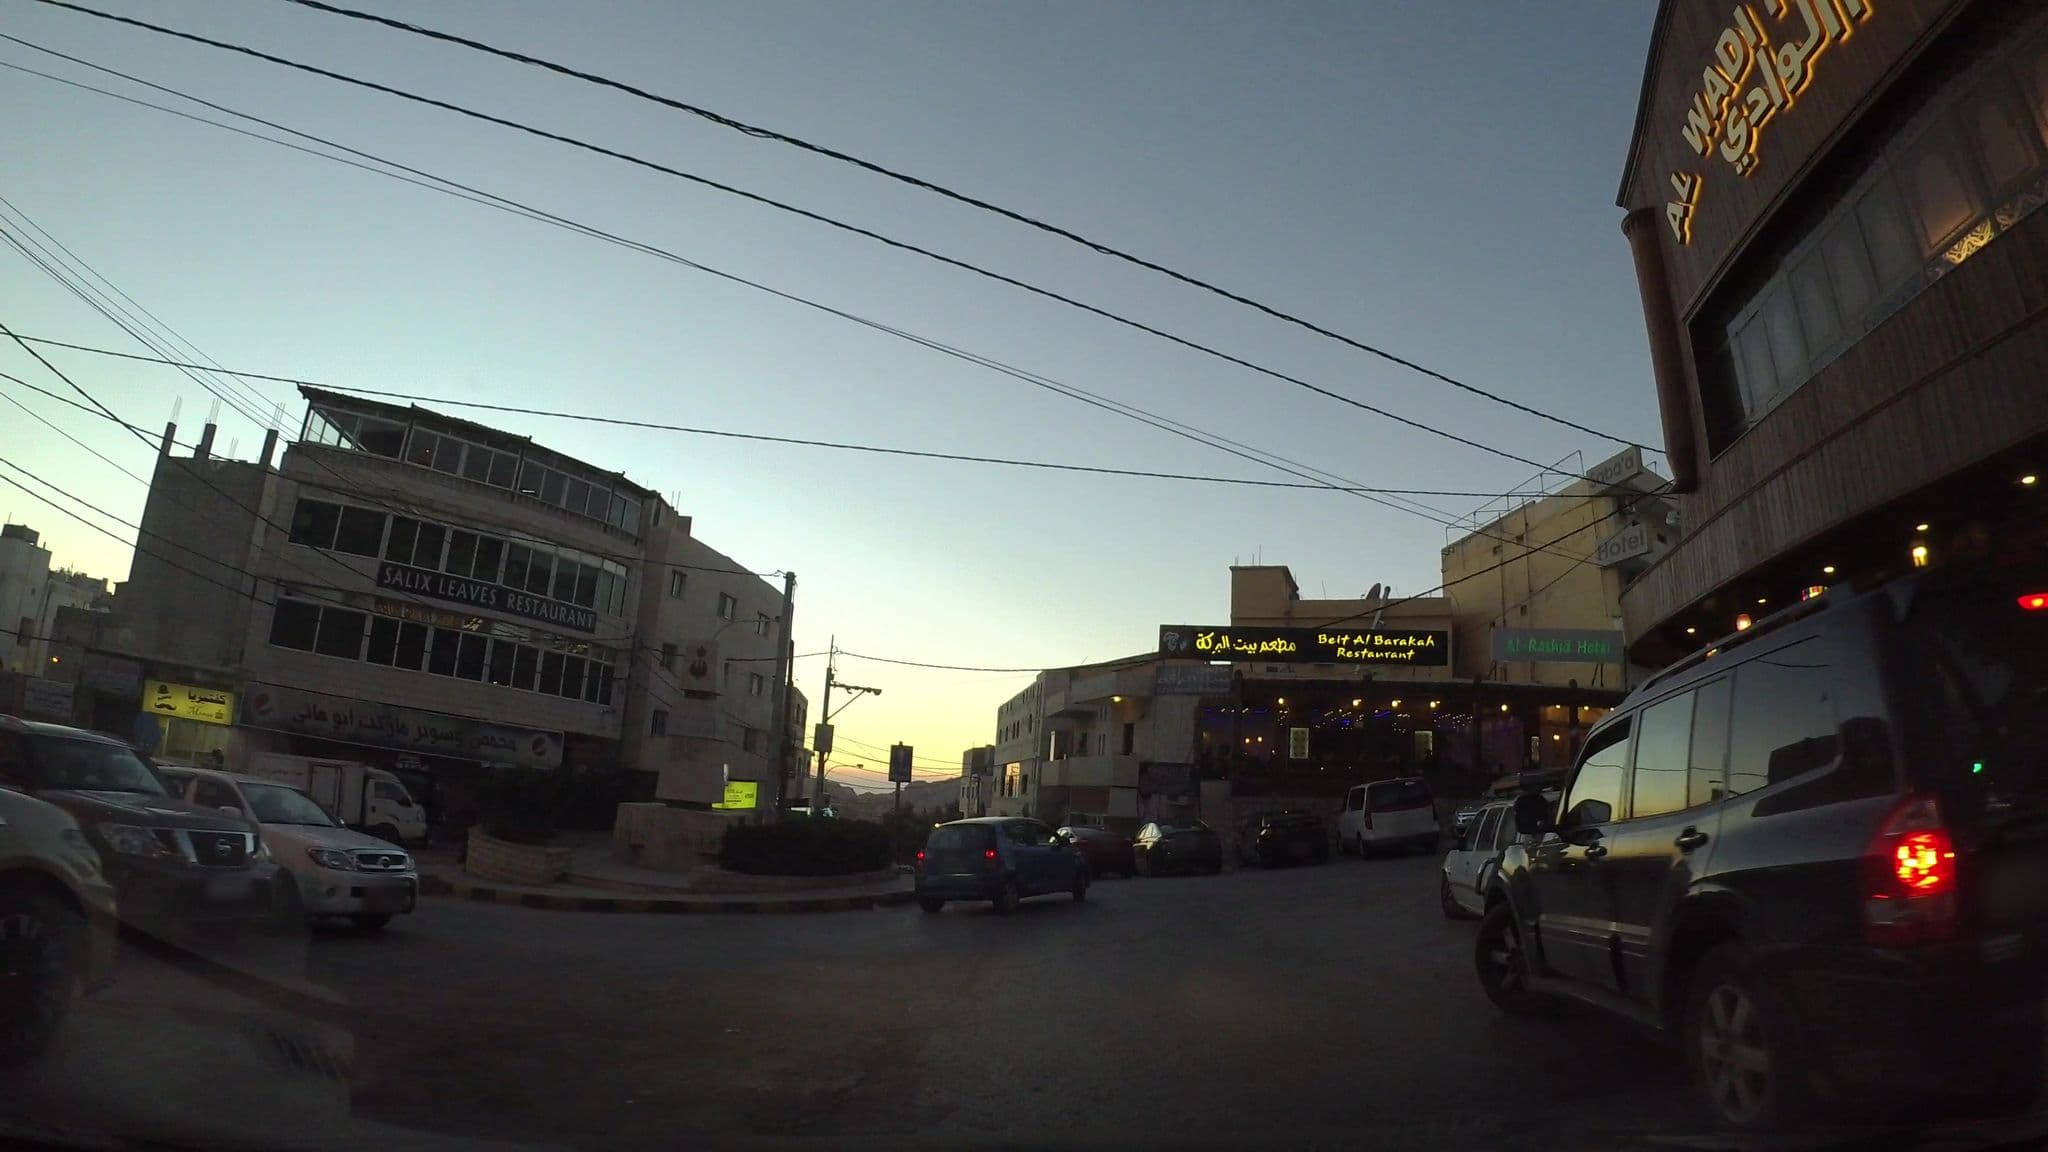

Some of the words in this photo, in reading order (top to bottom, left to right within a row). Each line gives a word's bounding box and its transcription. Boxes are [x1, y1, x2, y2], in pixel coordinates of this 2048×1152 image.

[1681, 4, 1764, 157] WADI
[1665, 172, 1700, 245] AL
[1598, 529, 1644, 561] Hotel
[383, 566, 433, 592] SALIX
[438, 578, 498, 605] LEAVES
[506, 592, 595, 629] RESTAURANT
[1195, 631, 1230, 654] البركة
[1232, 638, 1258, 654] بيت
[1259, 637, 1297, 653] مطعم
[1317, 633, 1351, 646] Beit
[1353, 634, 1372, 646] Al
[1373, 634, 1436, 648] Barakah
[1336, 647, 1416, 661] Restaurant
